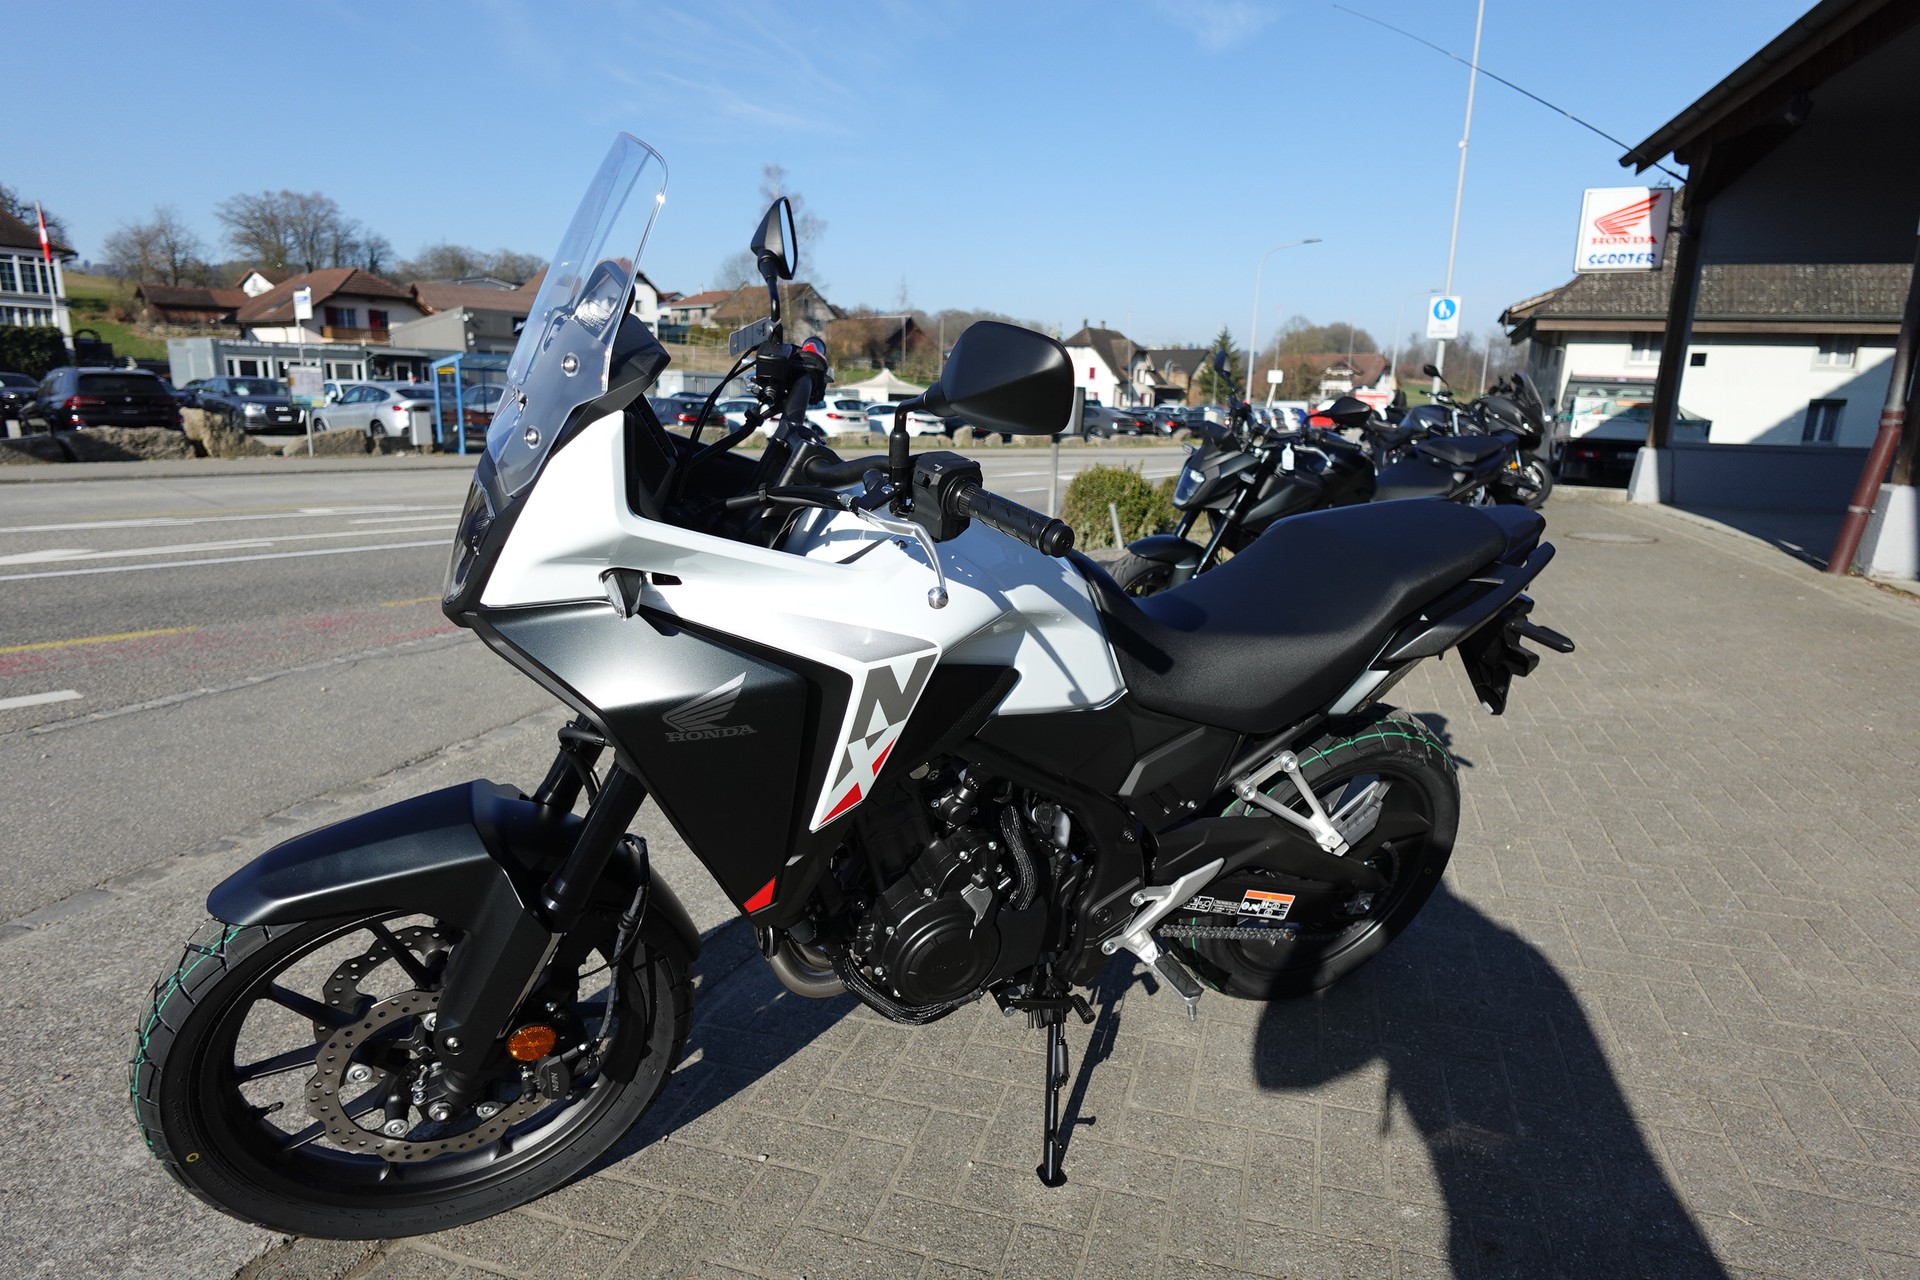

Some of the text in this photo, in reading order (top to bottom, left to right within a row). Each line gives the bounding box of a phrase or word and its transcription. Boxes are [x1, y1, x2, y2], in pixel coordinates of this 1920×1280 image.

[1591, 236, 1658, 245] HONDA
[1588, 253, 1656, 264] SCOOTER
[665, 724, 757, 743] HONDA
